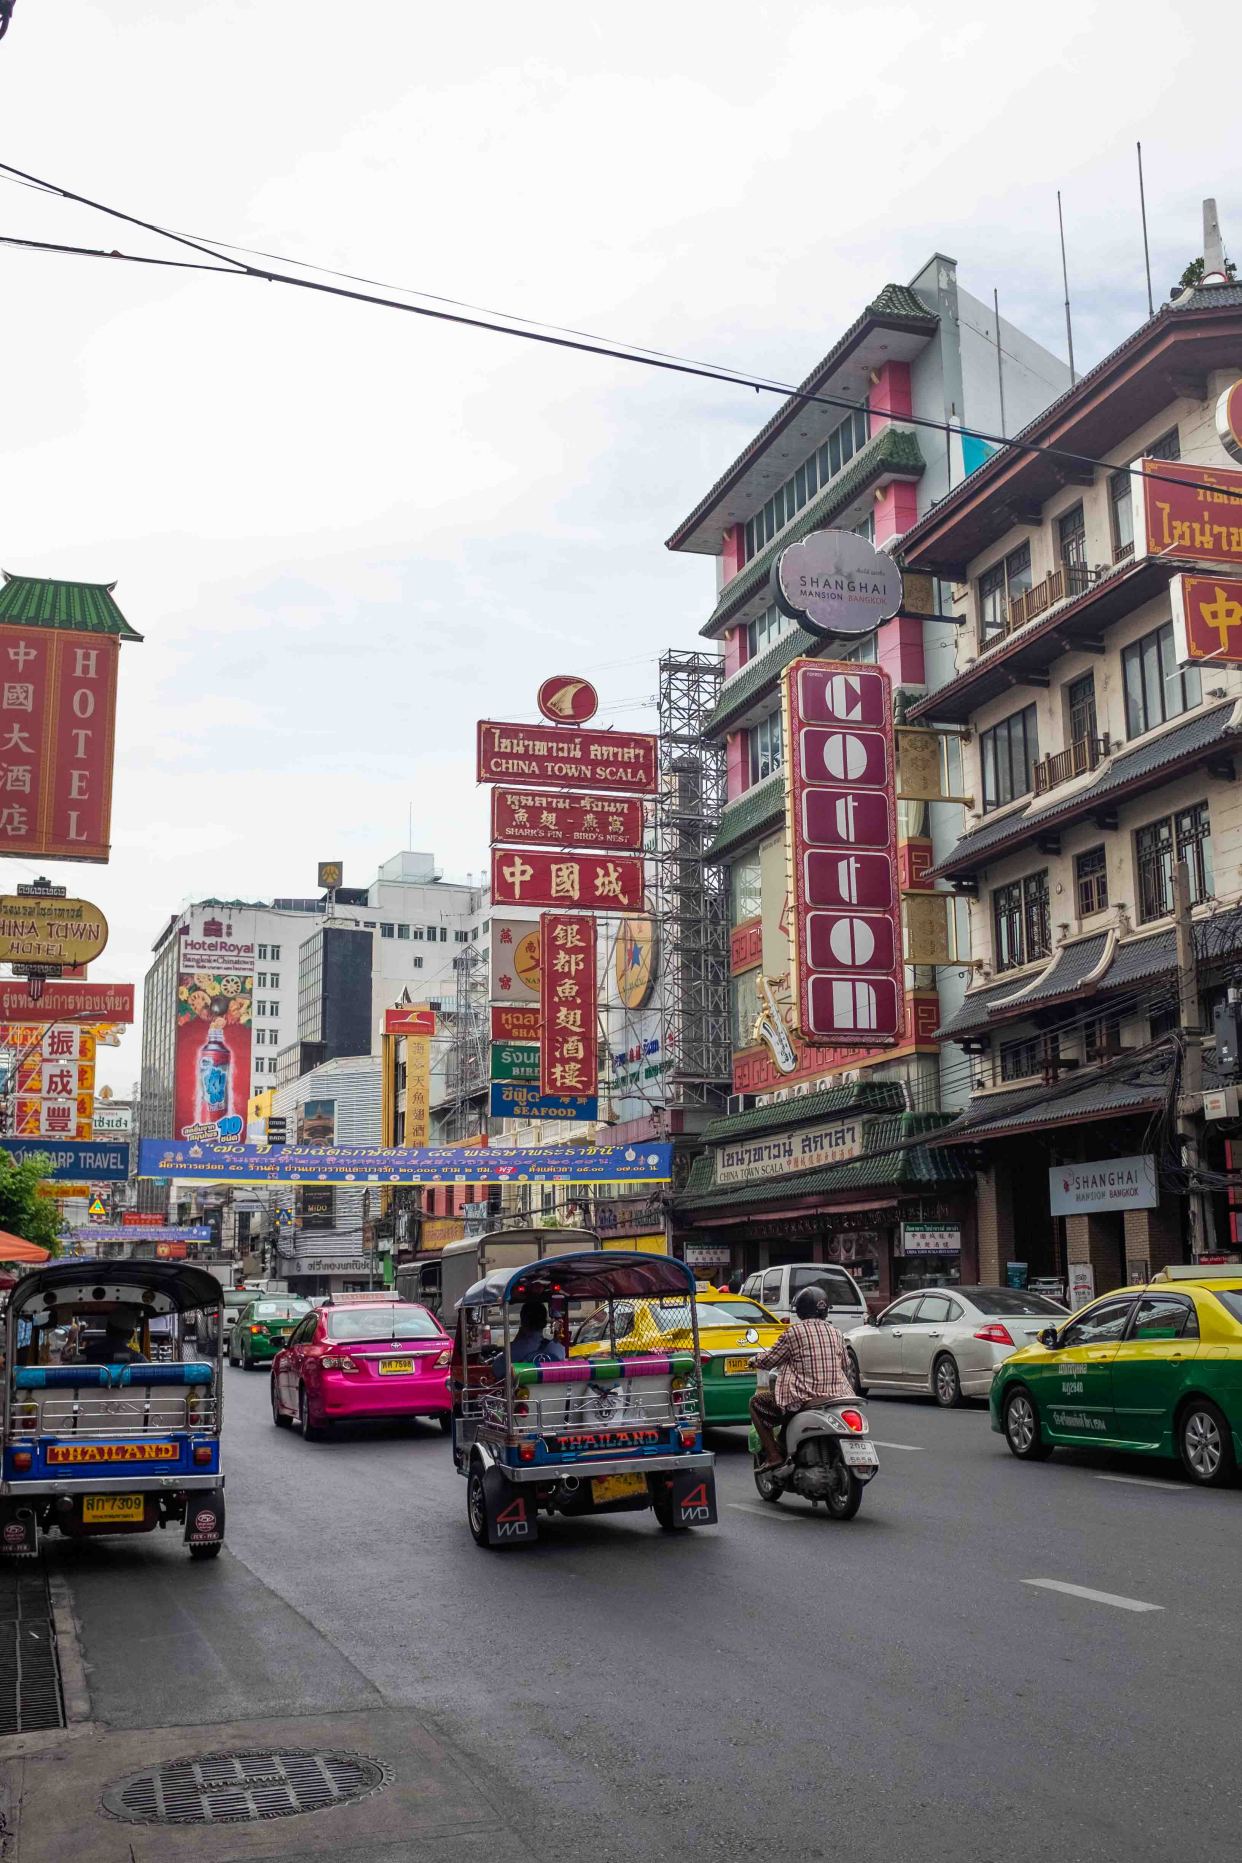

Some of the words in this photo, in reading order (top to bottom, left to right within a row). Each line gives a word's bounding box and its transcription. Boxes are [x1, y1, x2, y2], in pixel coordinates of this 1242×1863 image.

[800, 576, 887, 595] SHANGHAI
[800, 589, 843, 600] MANSION
[848, 595, 887, 605] BANGKOK
[1200, 586, 1242, 653] 中
[66, 648, 100, 840] HOTEL
[490, 758, 540, 775] CHINA
[544, 763, 592, 779] TOWN
[596, 766, 647, 783] SCALA
[505, 827, 545, 837] SHARK'S
[547, 829, 563, 839] FIN
[573, 832, 604, 841] BIRD'S
[606, 834, 631, 843] NEST
[502, 855, 629, 906] 中國城
[47, 922, 100, 941] TOWN
[10, 942, 67, 957] HOTEL
[185, 939, 218, 952] Hotel
[219, 941, 254, 956] Royal
[551, 924, 588, 1090] 銀都魚翅酒樓
[45, 1031, 74, 1132] 振成豐
[513, 1106, 577, 1117] SEAFOOD
[217, 1116, 243, 1136] 10
[79, 1151, 124, 1169] TRAVEL
[719, 1171, 739, 1182] CHINA
[740, 1167, 761, 1179] TOWN
[761, 1162, 784, 1176] SCALA
[1075, 1169, 1139, 1190] SHANGHAI
[1075, 1191, 1107, 1202] MANSION
[1109, 1187, 1139, 1199] BANGKOK
[308, 1205, 328, 1213] MIDO
[557, 1431, 660, 1450] THAILAND
[54, 1444, 174, 1461] THAILAND
[110, 1496, 141, 1511] 7309
